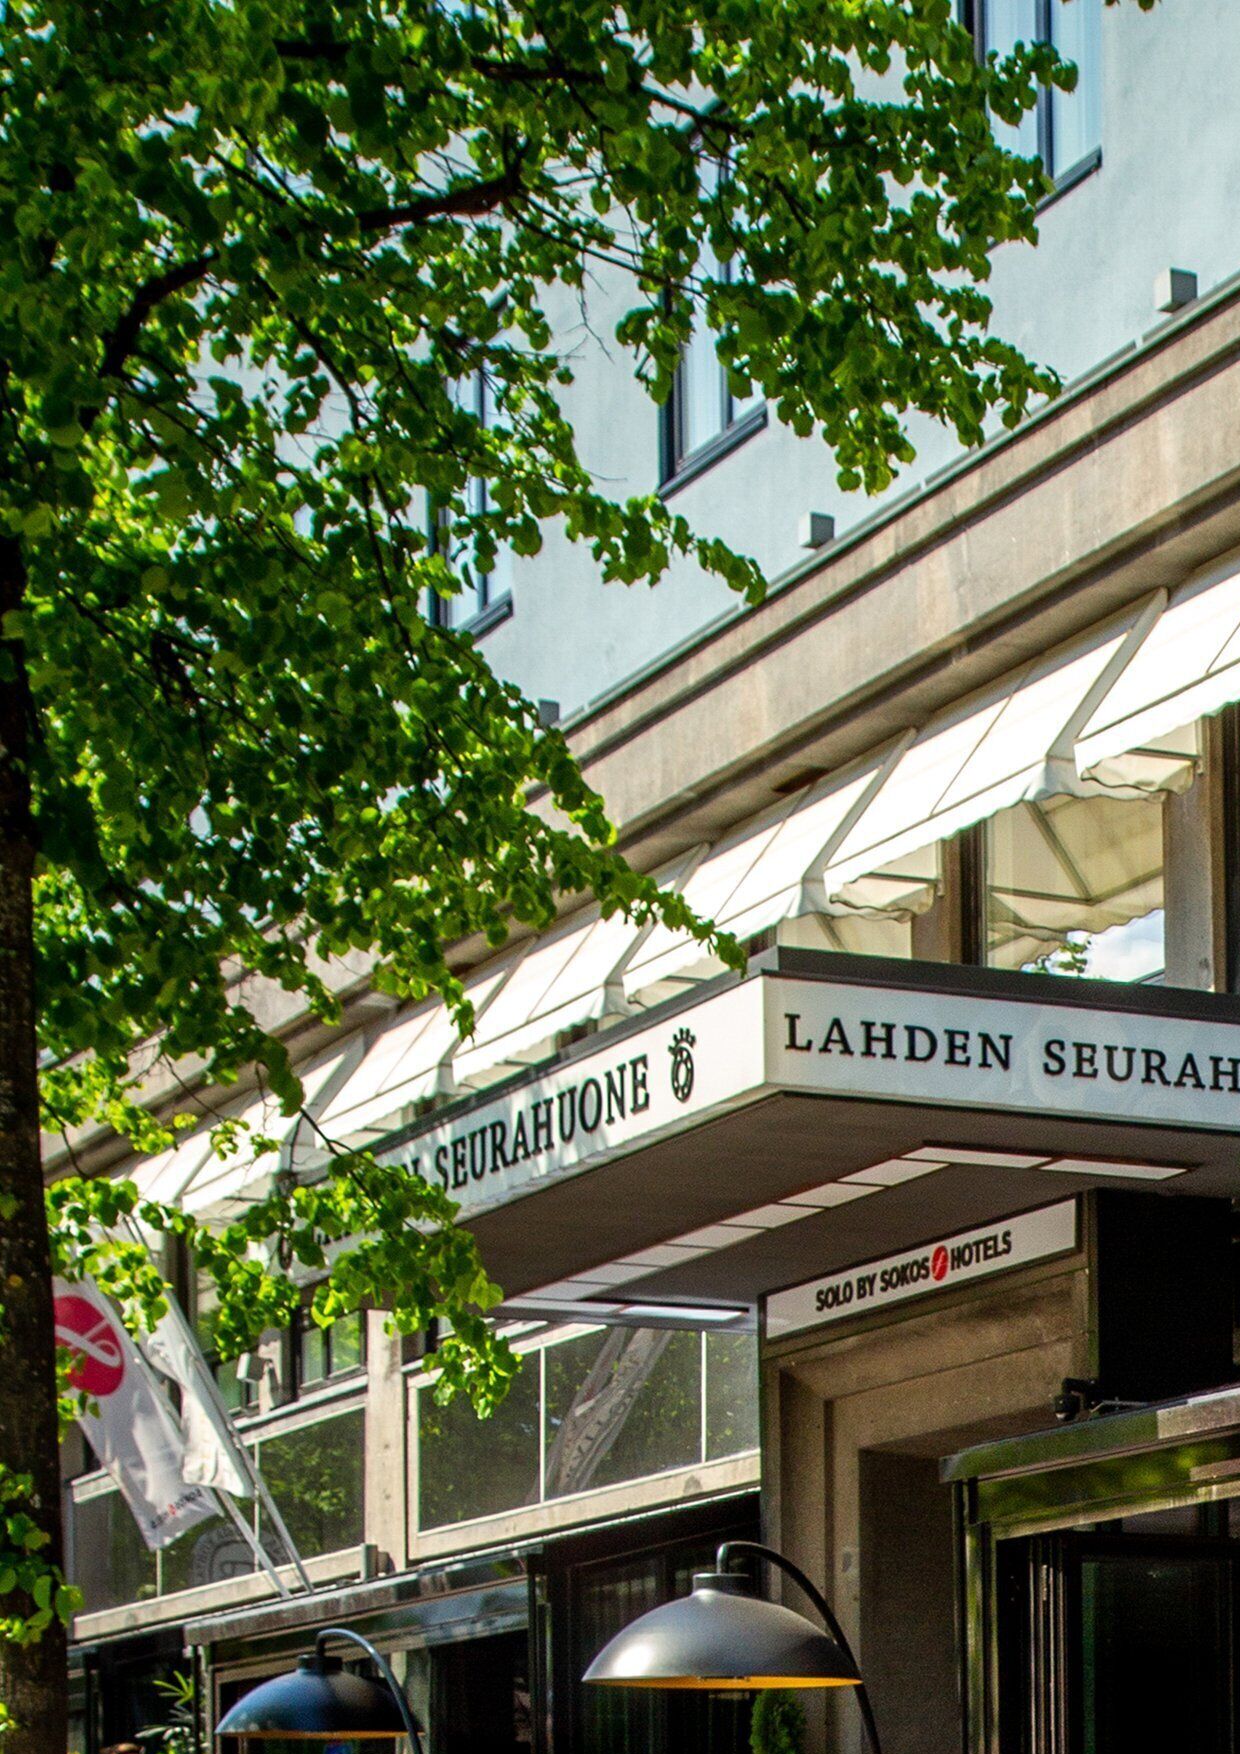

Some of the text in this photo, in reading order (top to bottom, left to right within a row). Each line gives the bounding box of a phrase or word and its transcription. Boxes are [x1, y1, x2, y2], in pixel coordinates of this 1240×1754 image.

[784, 1012, 1014, 1071] LAHDEN
[434, 1053, 651, 1192] SEURAHUONE
[815, 1230, 1012, 1312] SOLO BY SOKOS HOTELS
